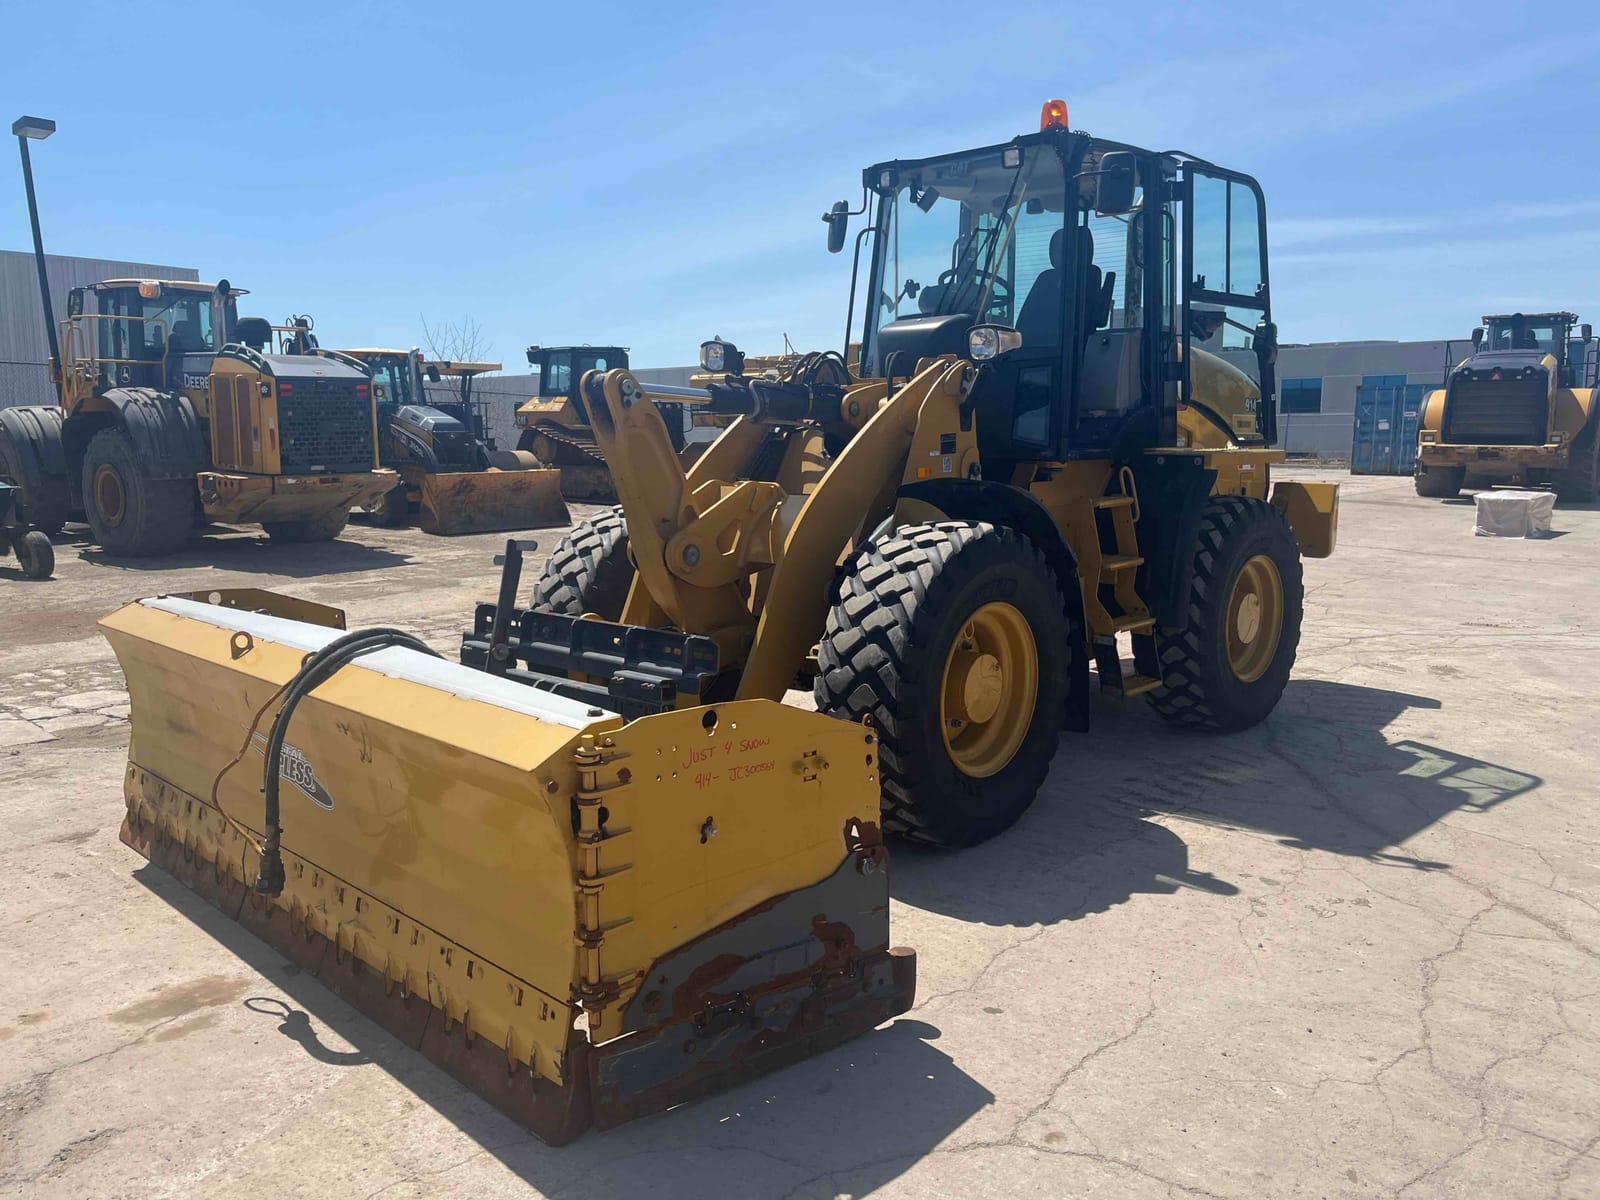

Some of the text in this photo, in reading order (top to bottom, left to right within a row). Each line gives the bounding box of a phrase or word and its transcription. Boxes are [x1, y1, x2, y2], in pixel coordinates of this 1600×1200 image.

[184, 373, 208, 390] DEERE
[682, 737, 770, 769] JUST 4 SNOW
